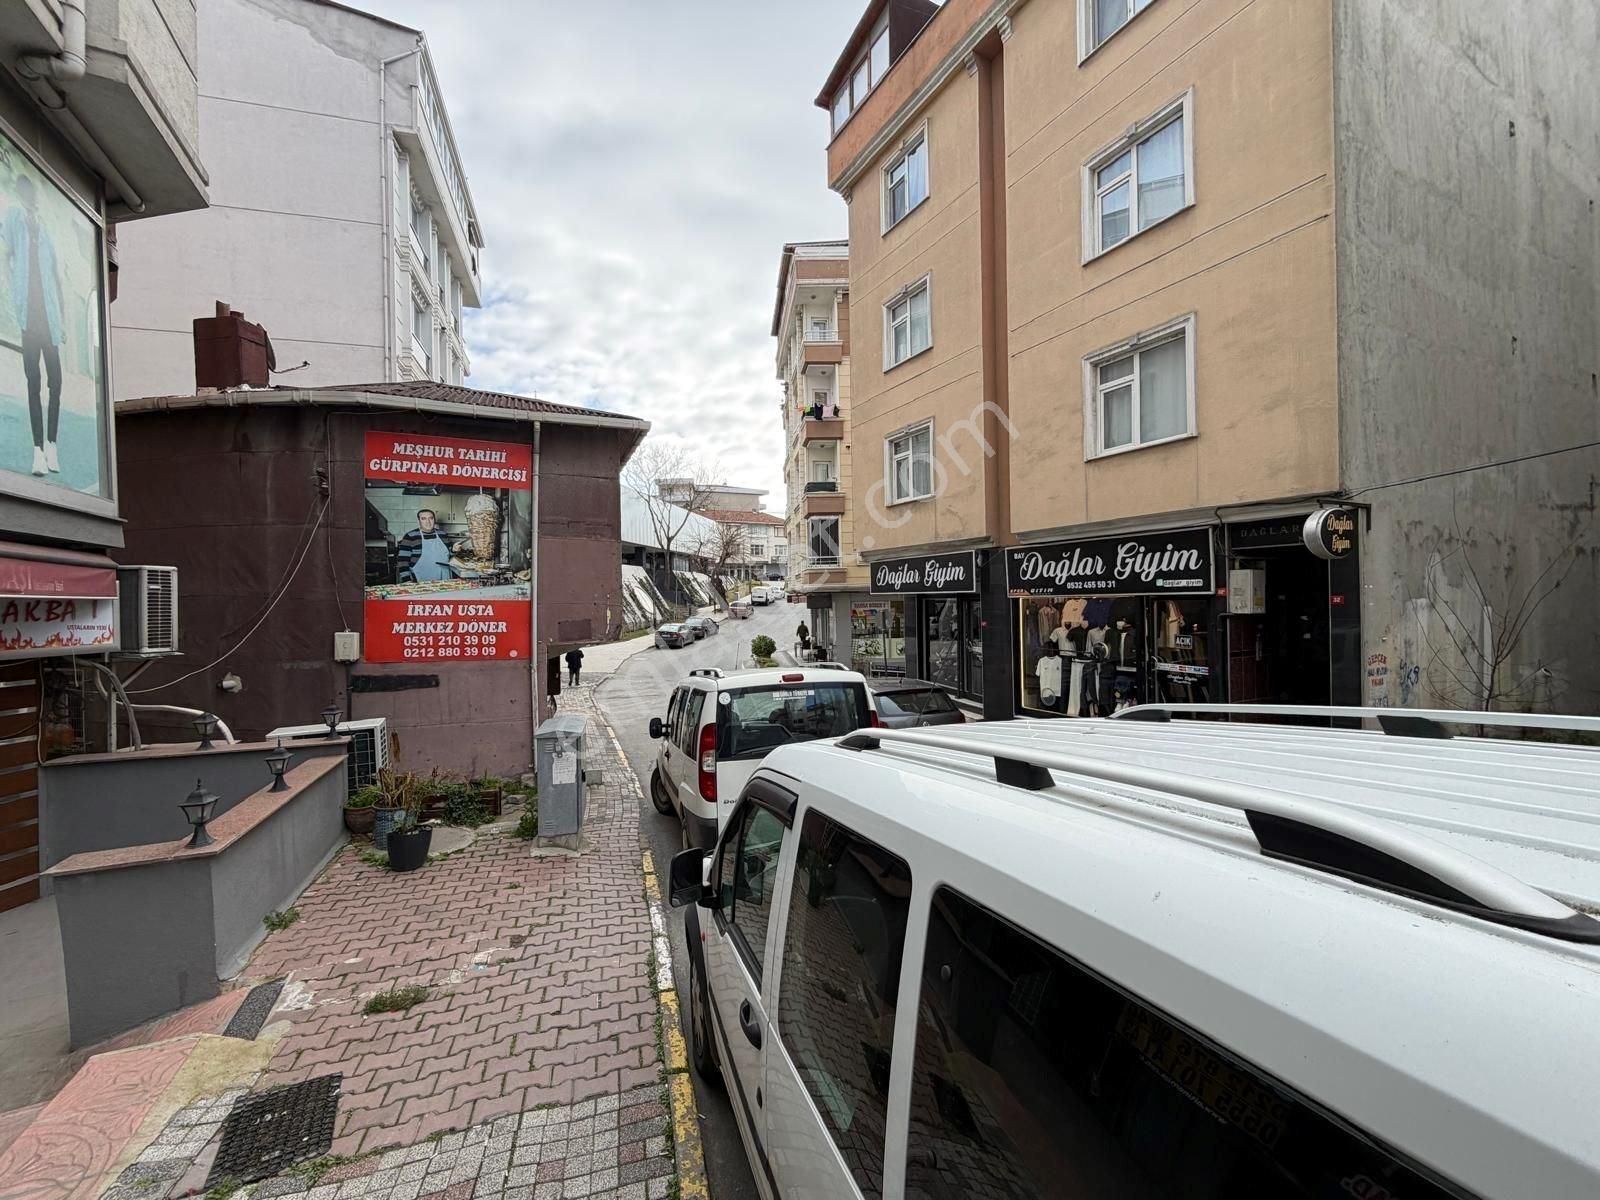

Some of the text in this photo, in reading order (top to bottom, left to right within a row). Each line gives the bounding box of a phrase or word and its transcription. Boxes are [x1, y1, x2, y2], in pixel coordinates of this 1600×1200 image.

[392, 442, 507, 463] MEŞHUR TARİHİ
[369, 456, 528, 482] GÜRPINAR DÖNERCİSİ
[1326, 514, 1353, 534] Dağlar
[1332, 534, 1350, 553] Giyim
[1019, 542, 1203, 586] Dağlar Giyim
[876, 559, 965, 590] Dağlar Giyim
[1066, 581, 1083, 589] 0532
[1097, 580, 1107, 588] 50
[406, 601, 494, 617] İRFAN USTA
[392, 618, 508, 634] MERKEZ DÖNER
[403, 636, 496, 646] 0531 210 39 09
[404, 647, 496, 658] 0212 880 39 09
